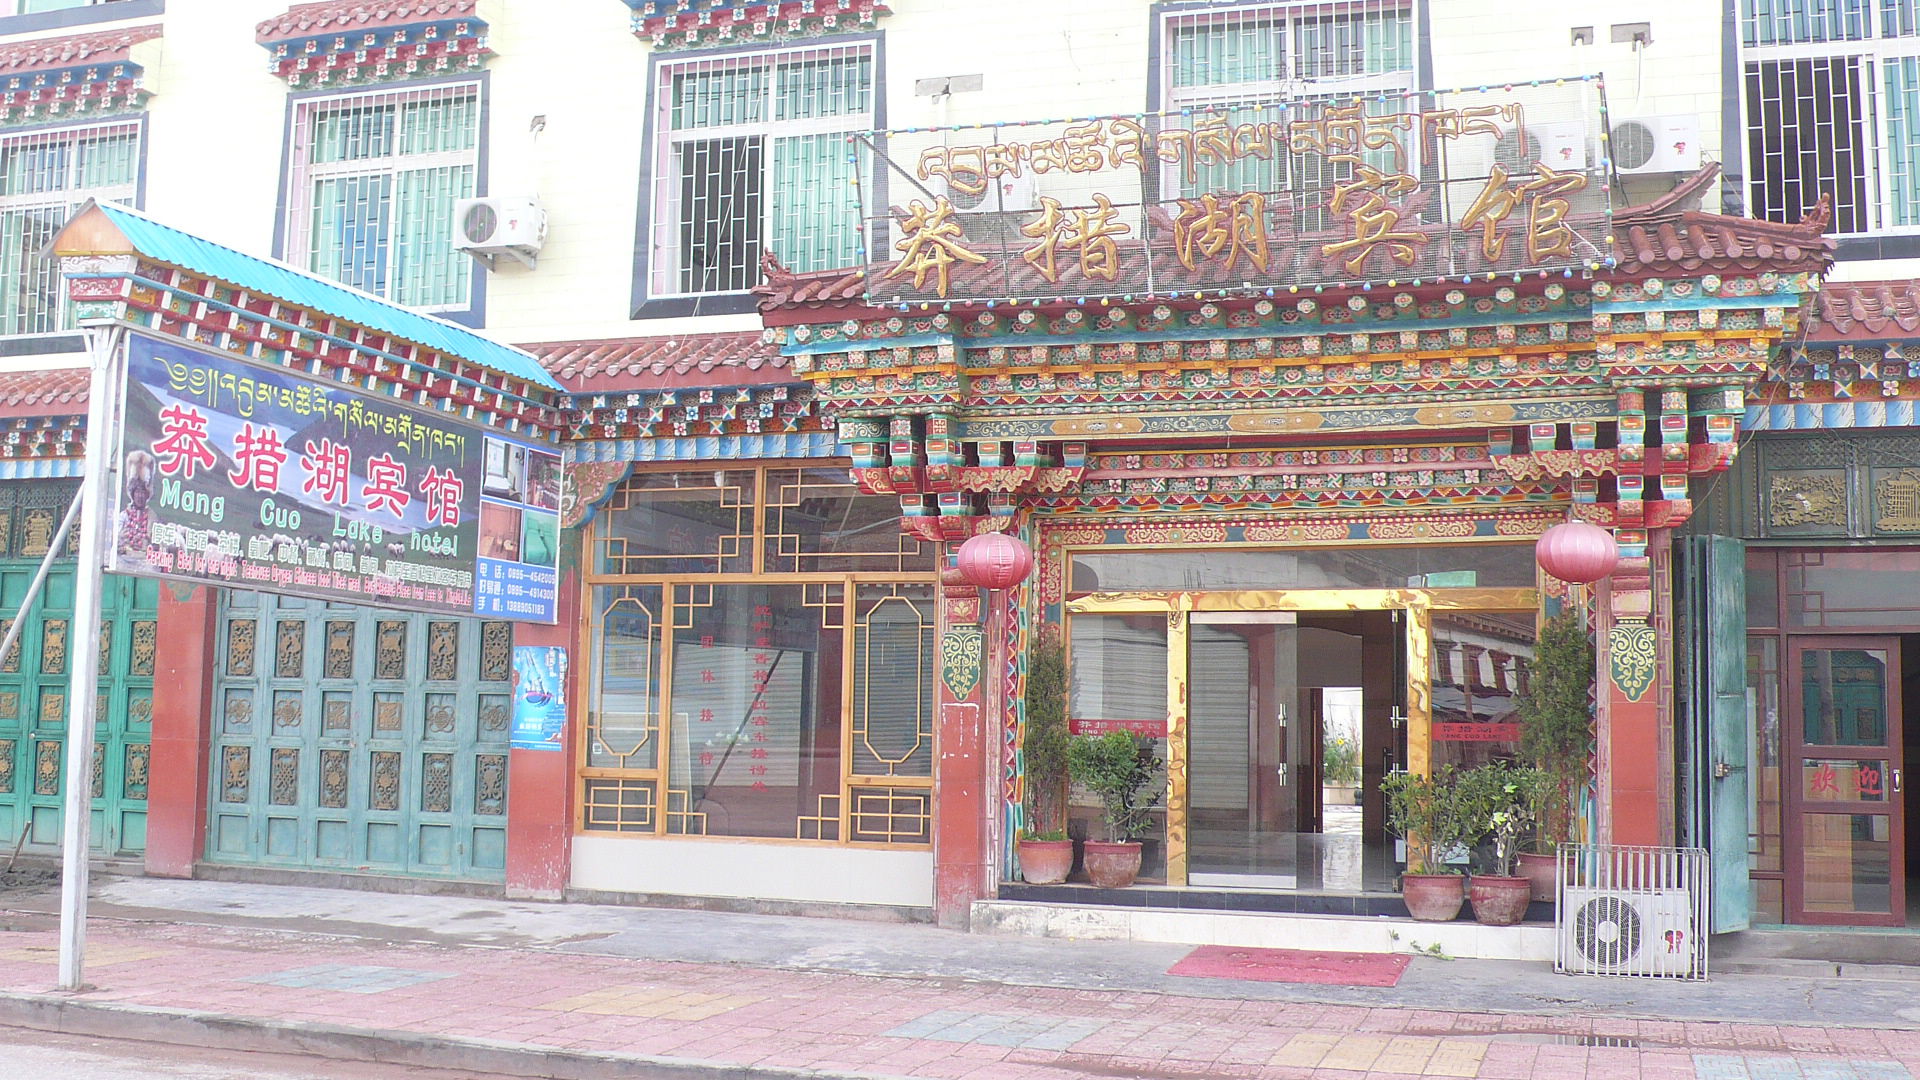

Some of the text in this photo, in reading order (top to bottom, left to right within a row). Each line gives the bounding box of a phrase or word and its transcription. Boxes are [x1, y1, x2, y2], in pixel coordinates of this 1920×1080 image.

[883, 160, 1588, 298] 莽措湖宾馆
[152, 404, 463, 527] 莽措湖宾馆
[146, 544, 174, 573] Parking
[294, 567, 317, 586] Chinese
[160, 478, 458, 557] Mang Cuo Lake hotel
[699, 635, 714, 765] 团体接待
[1811, 763, 1884, 795] 欢迎
